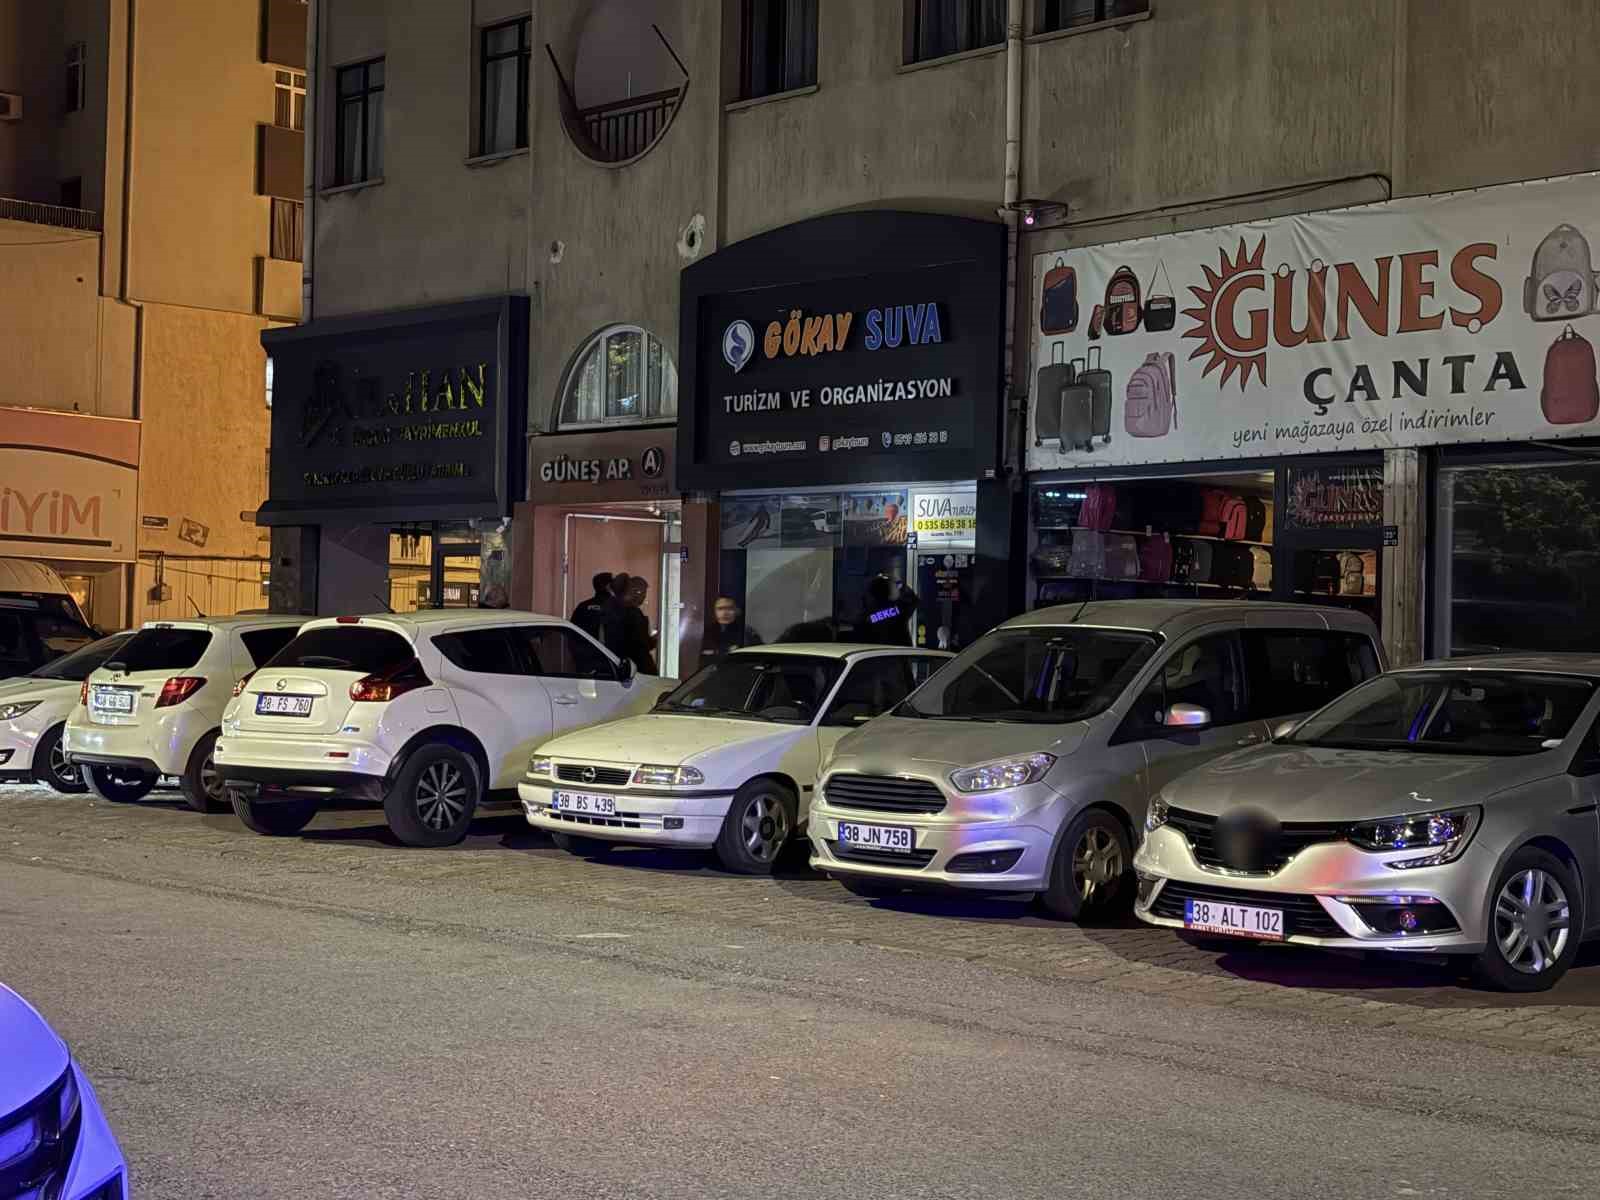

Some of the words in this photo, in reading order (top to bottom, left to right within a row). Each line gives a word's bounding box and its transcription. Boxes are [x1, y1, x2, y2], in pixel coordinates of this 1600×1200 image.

[1214, 242, 1503, 352] GÜNEŞ
[764, 309, 852, 359] GÖKAY
[864, 302, 942, 351] SUVA
[724, 389, 780, 413] TURİZM
[791, 389, 810, 409] VE
[820, 378, 951, 406] ORGANİZASYON
[1302, 351, 1527, 416] ÇANTA
[1233, 422, 1269, 448] yeni
[1275, 419, 1354, 444] mağazaya
[1361, 412, 1393, 433] özel
[1400, 406, 1496, 430] indirimler
[540, 454, 600, 483] GÜNEŞ
[606, 458, 631, 479] AP.
[644, 450, 657, 471] A
[918, 498, 952, 518] SUVA
[924, 520, 938, 530] 535
[262, 696, 272, 710] 38
[277, 697, 289, 711] FS
[293, 698, 310, 712] 760
[559, 793, 570, 808] 38
[576, 795, 589, 810] BS
[594, 797, 613, 813] 439
[844, 825, 859, 841] 38
[863, 827, 881, 844] JN
[884, 829, 909, 847] 758
[1193, 903, 1210, 924] 38
[1221, 907, 1249, 928] ALT
[1255, 910, 1280, 932] 102
